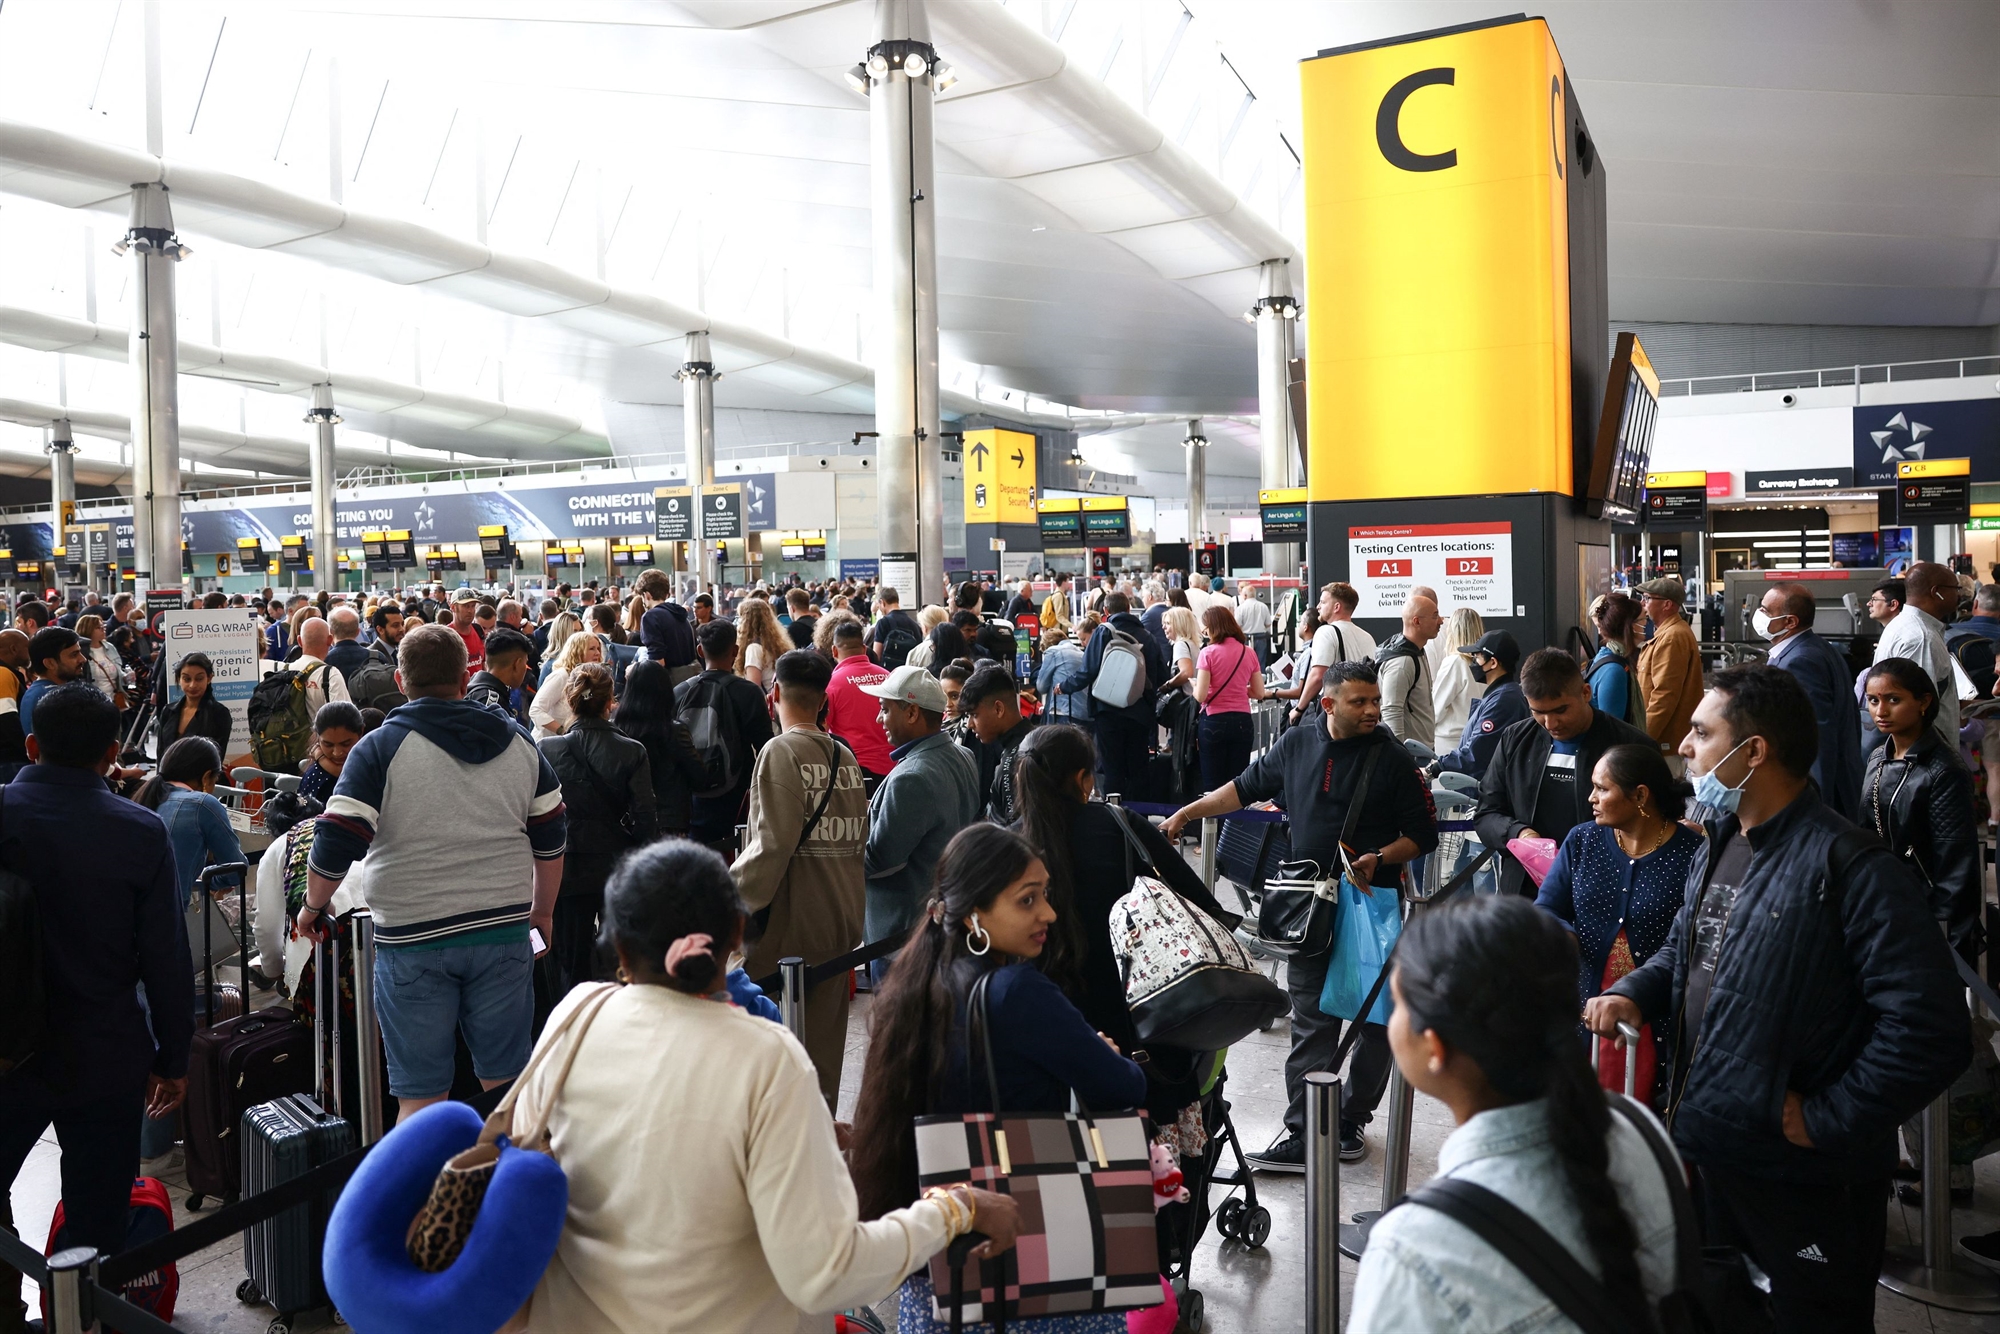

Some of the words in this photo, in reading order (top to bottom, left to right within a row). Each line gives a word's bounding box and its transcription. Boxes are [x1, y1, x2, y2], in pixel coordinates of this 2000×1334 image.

[1376, 67, 1457, 172] C
[1551, 74, 1562, 180] C
[1759, 480, 1797, 488] Currency
[1798, 478, 1839, 487] Exchange
[1000, 484, 1028, 495] Departures
[1008, 496, 1028, 509] Security
[368, 509, 392, 520] YOU
[572, 513, 609, 527] WITH
[612, 511, 642, 525] THE
[1354, 545, 1393, 555] Testing
[1396, 543, 1438, 552] Centres
[1441, 542, 1495, 551] locations:
[1380, 563, 1399, 574] A1
[1460, 560, 1479, 572] D2
[197, 624, 220, 633] BAG
[222, 623, 253, 632] WRAP
[804, 816, 866, 841] ROW
[1797, 1251, 1828, 1263] adidas
